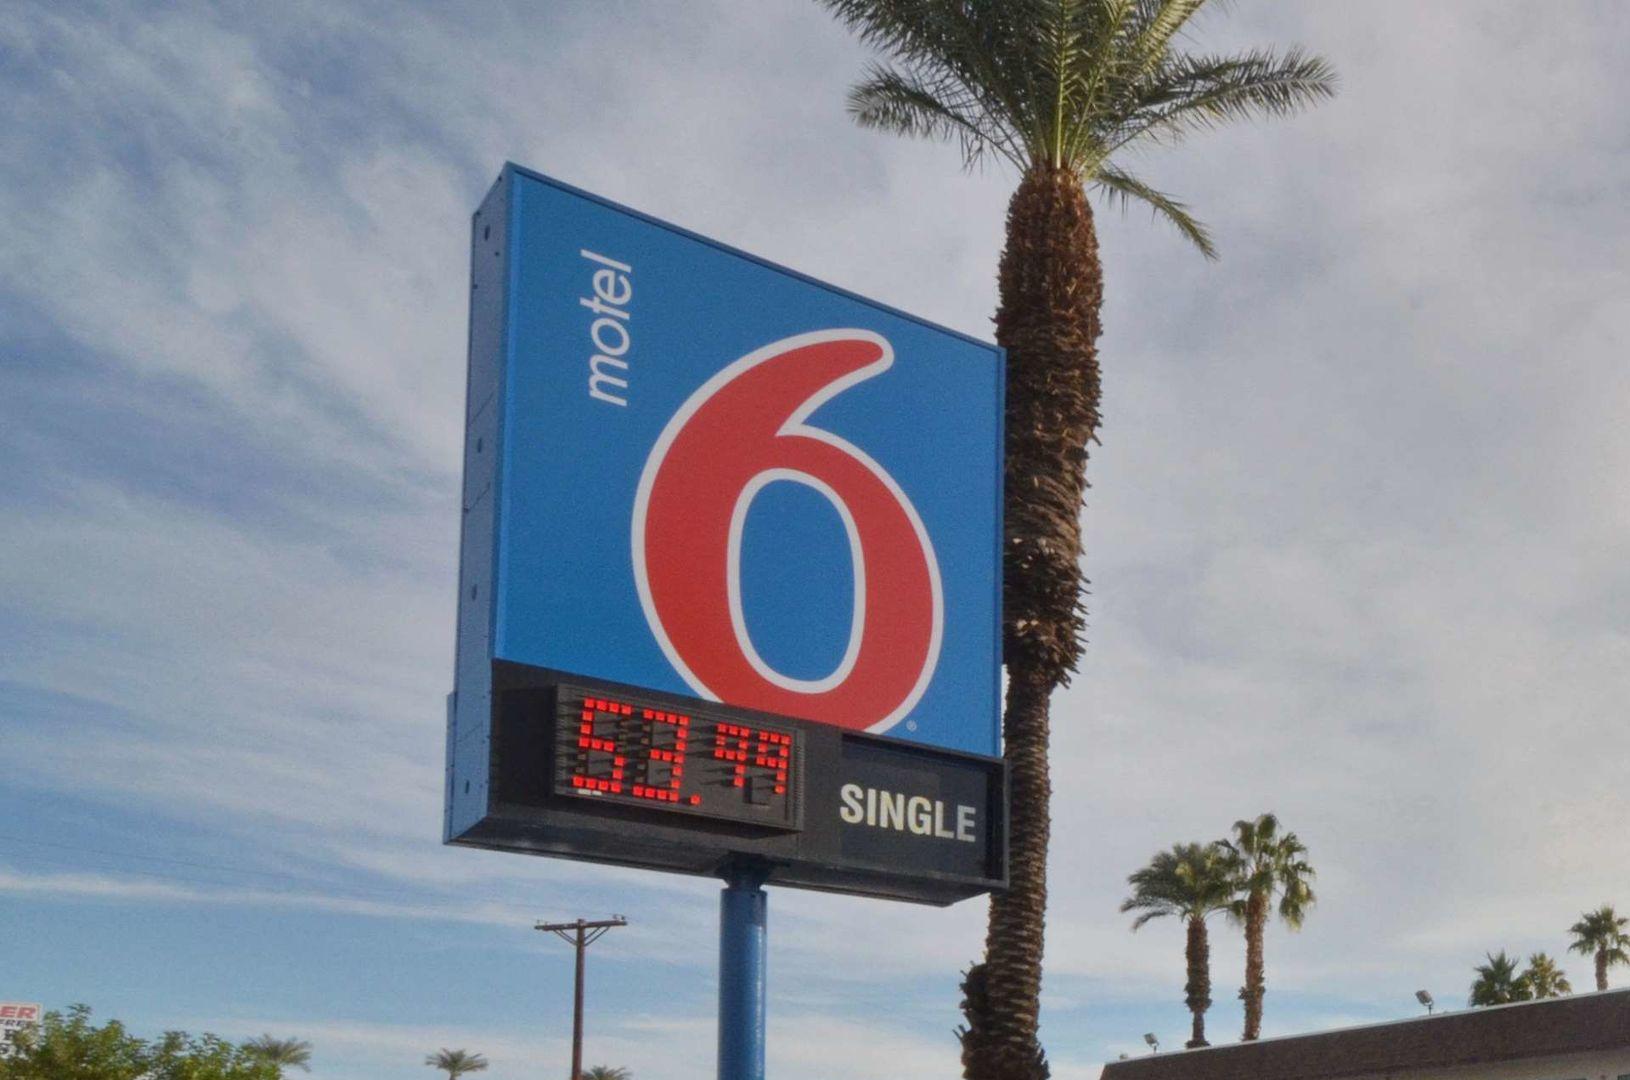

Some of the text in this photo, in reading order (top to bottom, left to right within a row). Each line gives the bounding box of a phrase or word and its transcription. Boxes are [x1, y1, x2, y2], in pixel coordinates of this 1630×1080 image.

[579, 249, 632, 406] motel
[631, 328, 944, 735] 6
[839, 783, 977, 842] SINGLE
